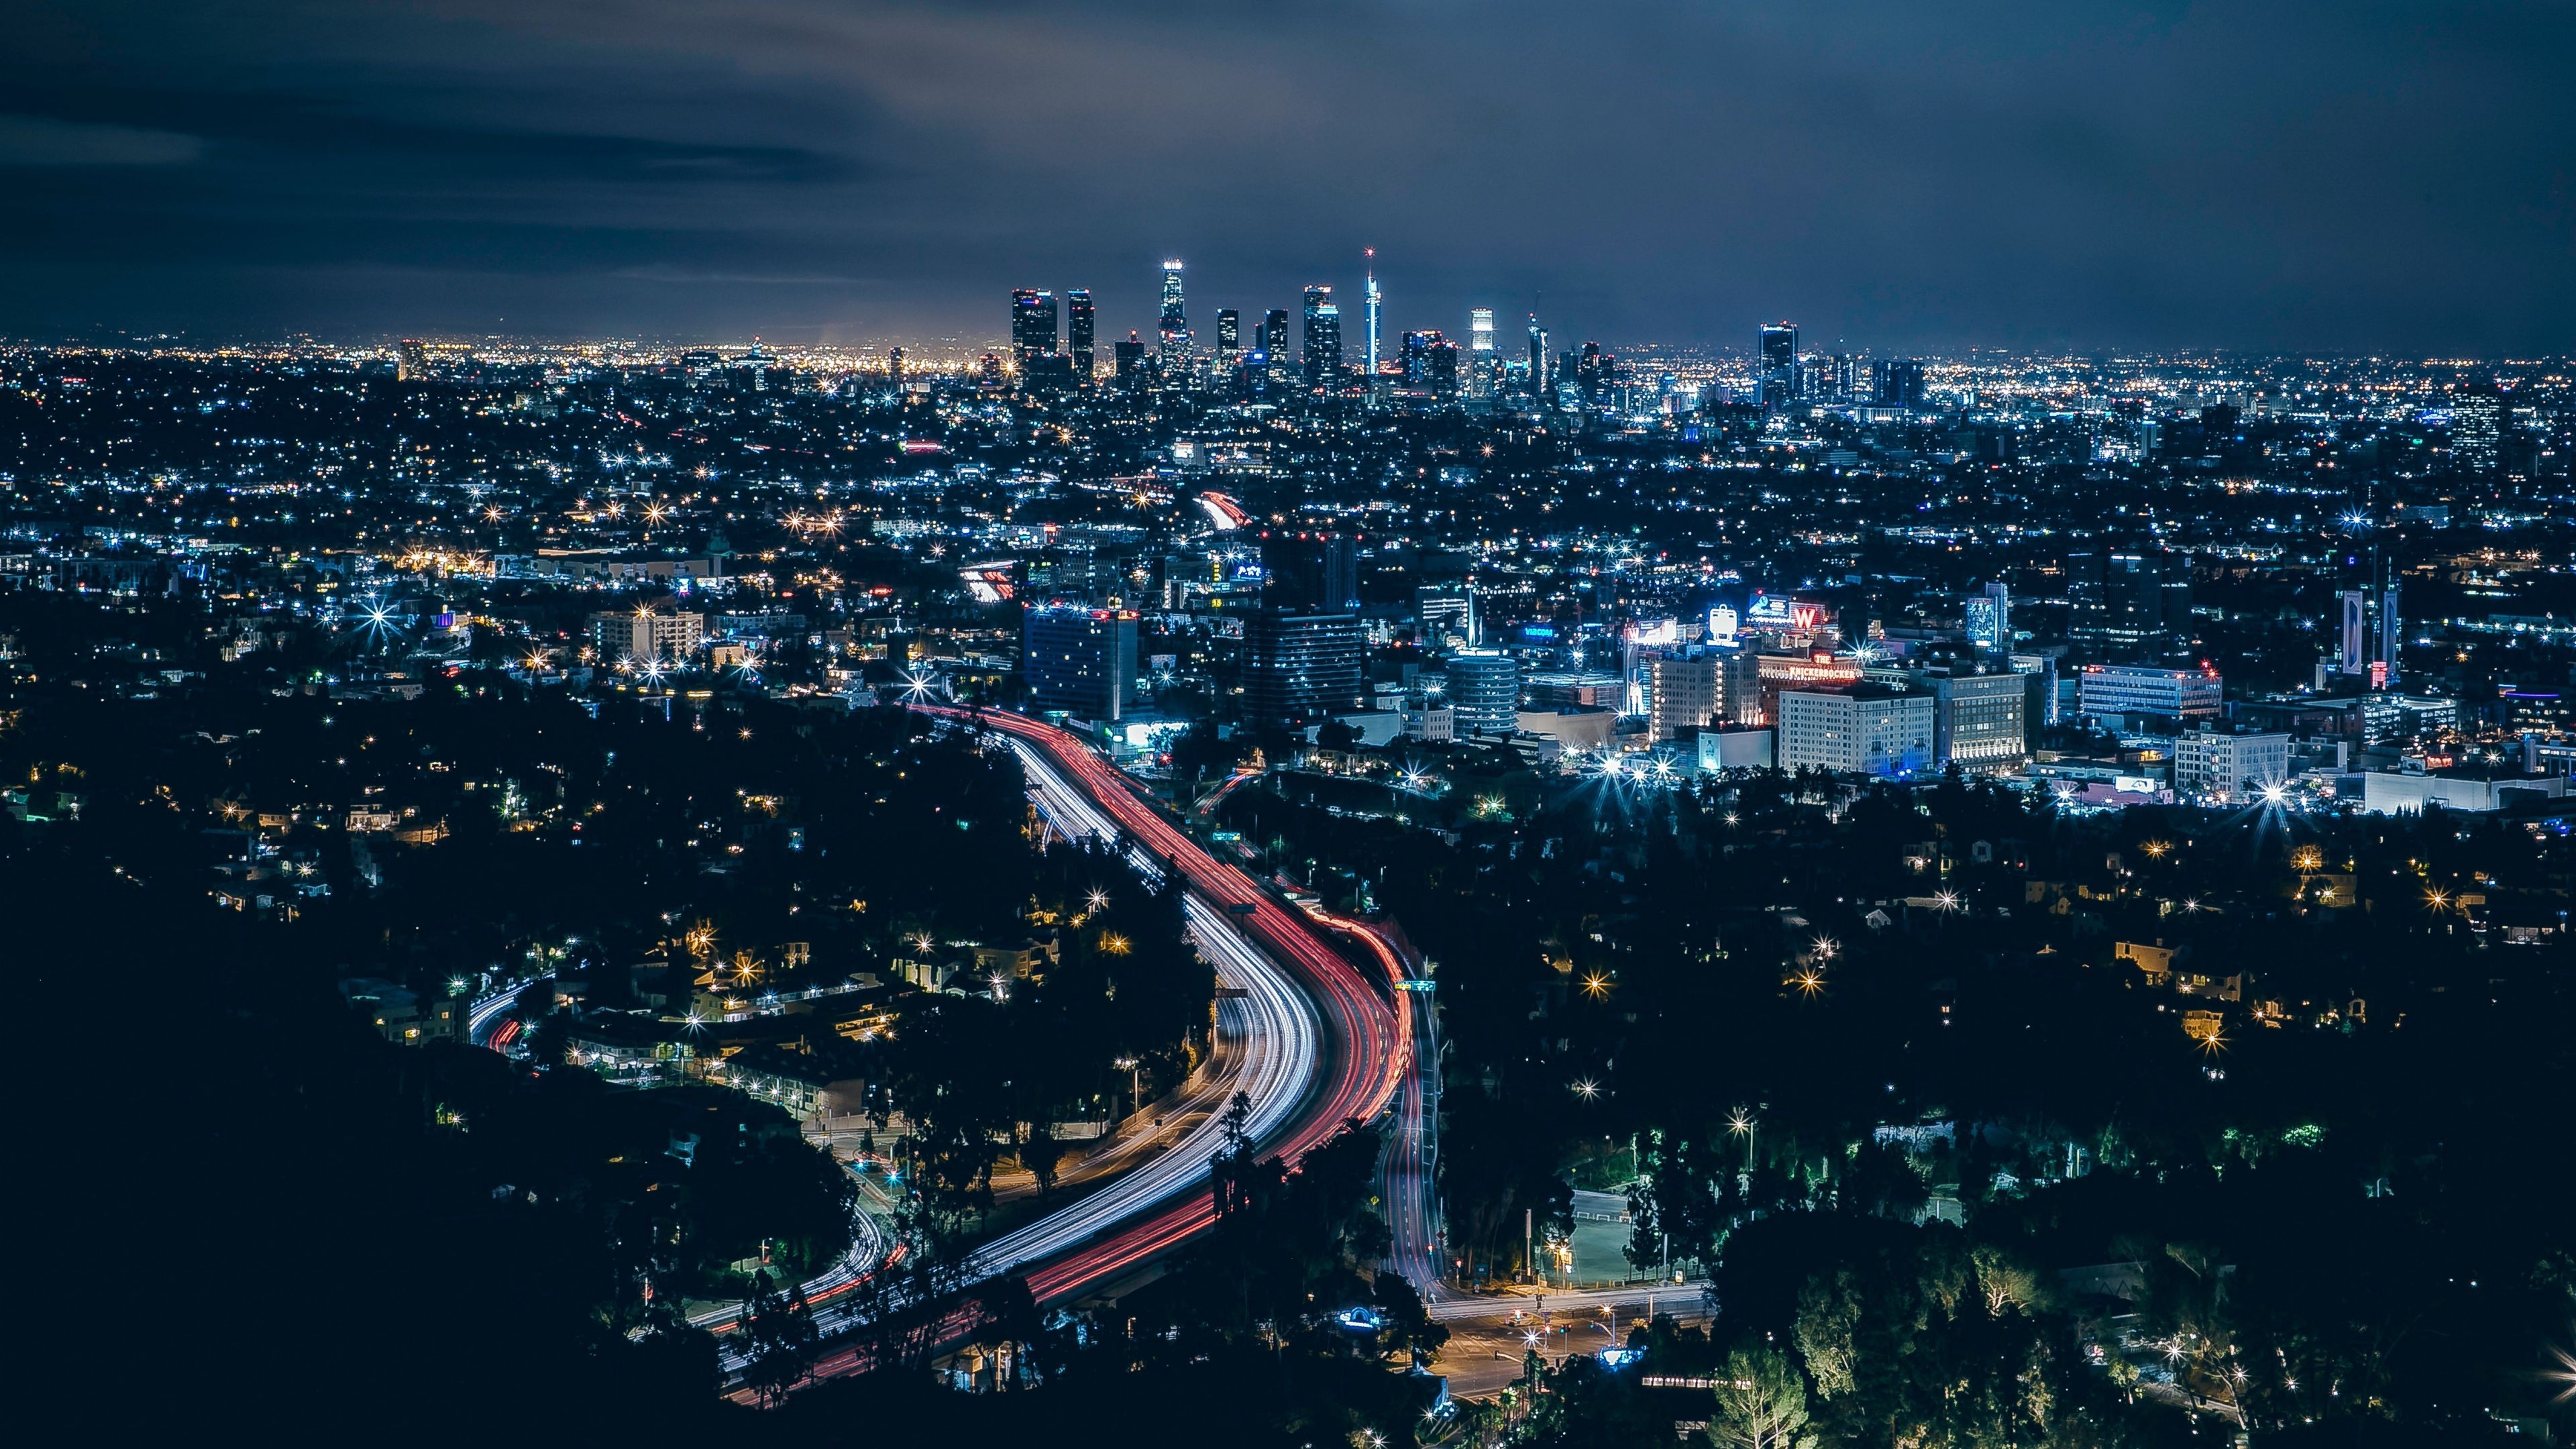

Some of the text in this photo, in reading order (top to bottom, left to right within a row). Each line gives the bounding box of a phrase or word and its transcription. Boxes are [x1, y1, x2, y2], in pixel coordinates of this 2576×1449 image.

[1794, 608, 1816, 629] W
[1814, 655, 1831, 664] THE
[1789, 667, 1856, 679] KNICKERBOCKER
